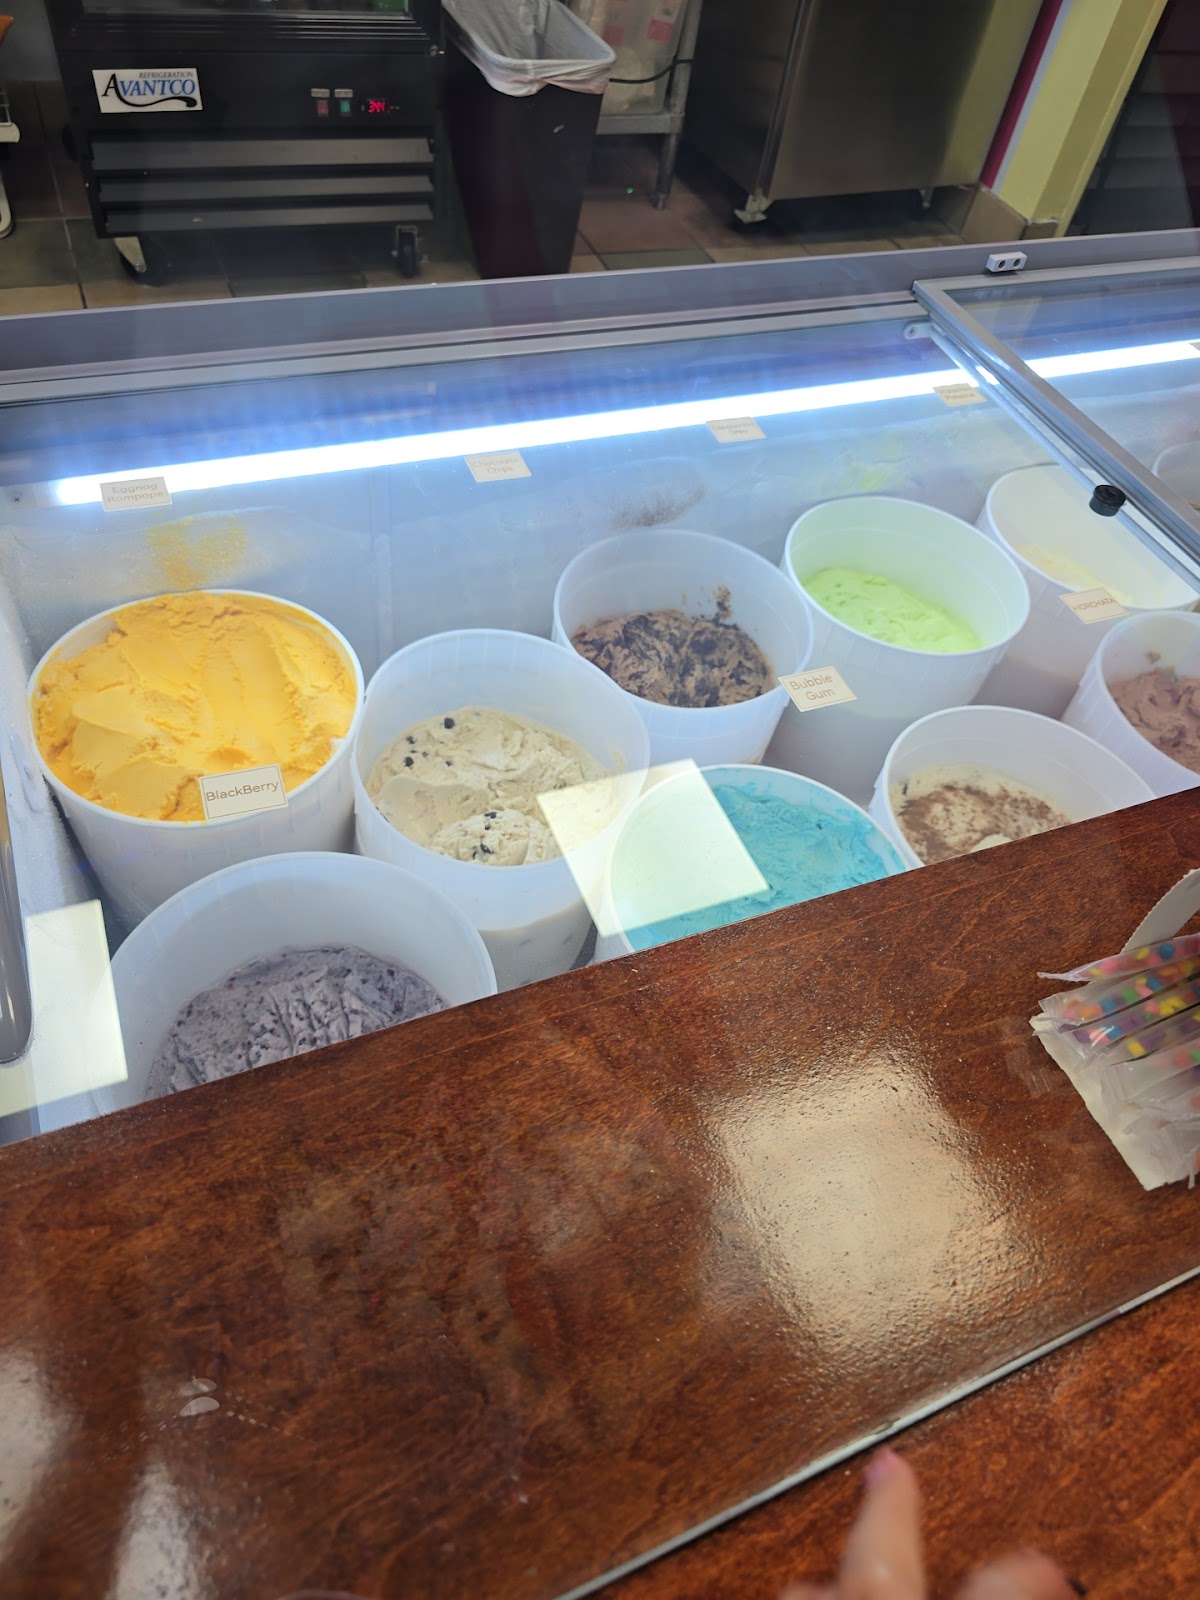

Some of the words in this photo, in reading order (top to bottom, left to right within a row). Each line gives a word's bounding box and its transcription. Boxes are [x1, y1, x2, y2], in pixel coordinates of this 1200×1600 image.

[101, 73, 197, 107] AVANTCO
[112, 484, 158, 495] Eggnog
[107, 492, 165, 503] Rompope
[788, 674, 833, 691] Bubble
[805, 688, 835, 701] Gum
[206, 781, 279, 802] BlackBerry
